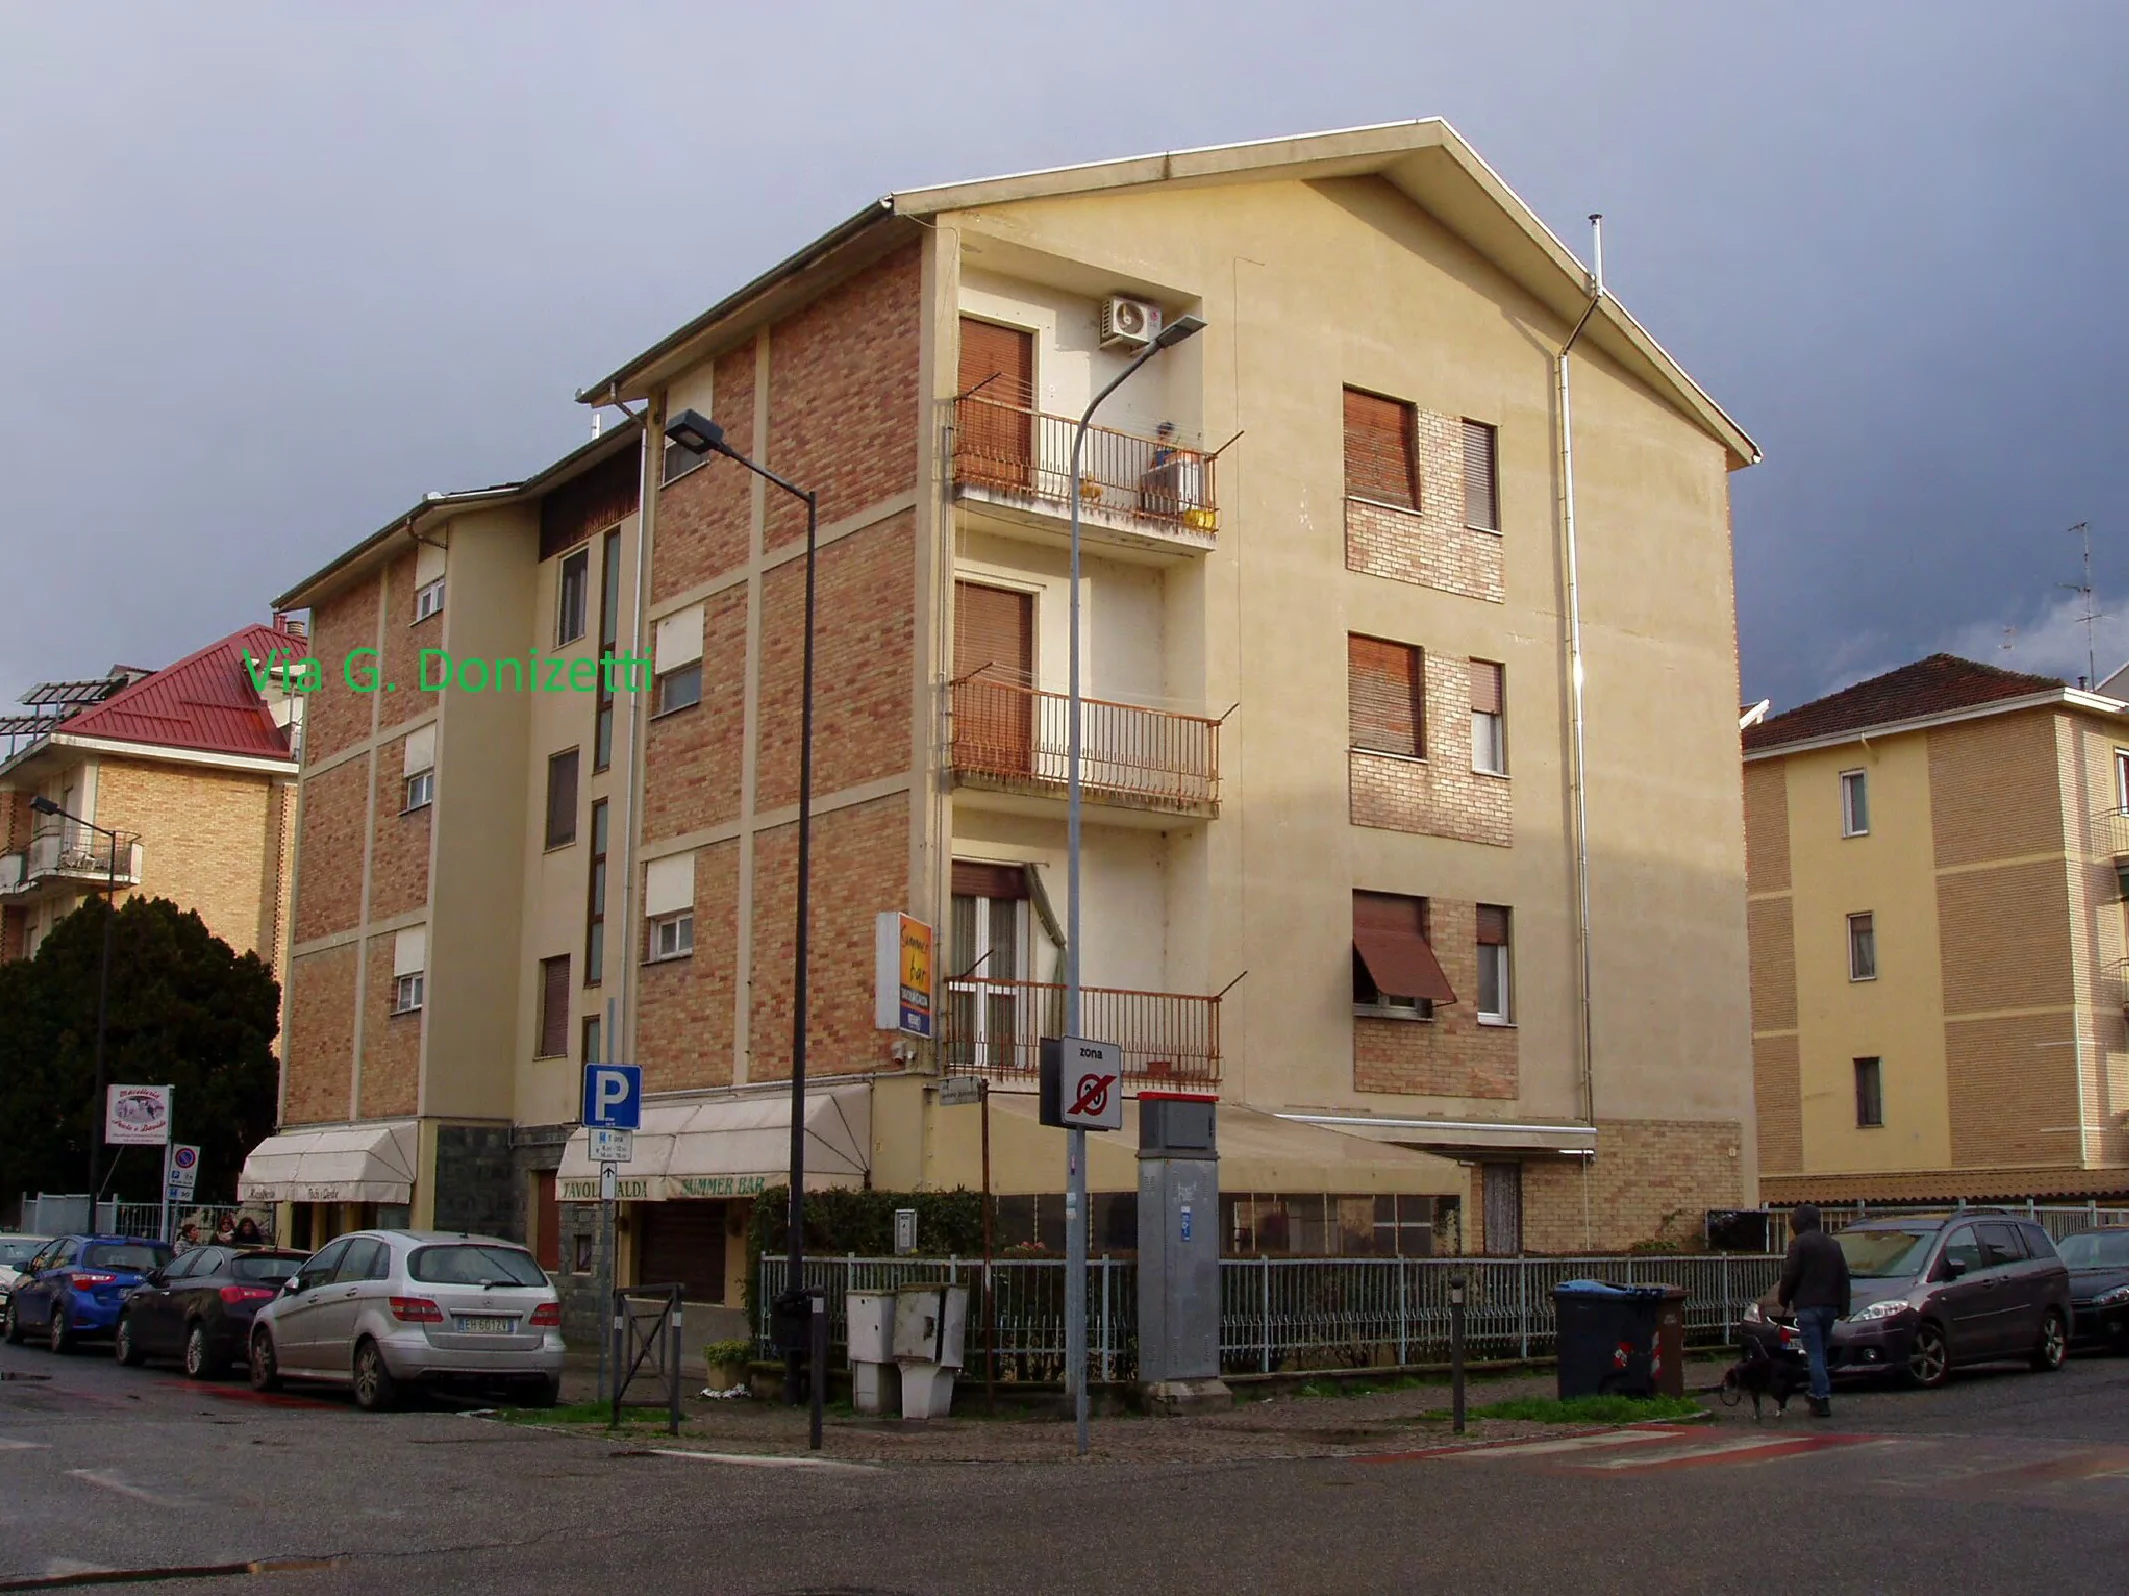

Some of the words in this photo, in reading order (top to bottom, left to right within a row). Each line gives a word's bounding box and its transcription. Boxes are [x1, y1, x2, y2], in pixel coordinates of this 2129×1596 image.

[1079, 1047, 1103, 1059] zona
[595, 1070, 629, 1121] P
[563, 1181, 602, 1198] TAVOL
[616, 1181, 648, 1198] ALDA
[681, 1177, 734, 1197] SUMMER
[737, 1175, 766, 1195] BAR
